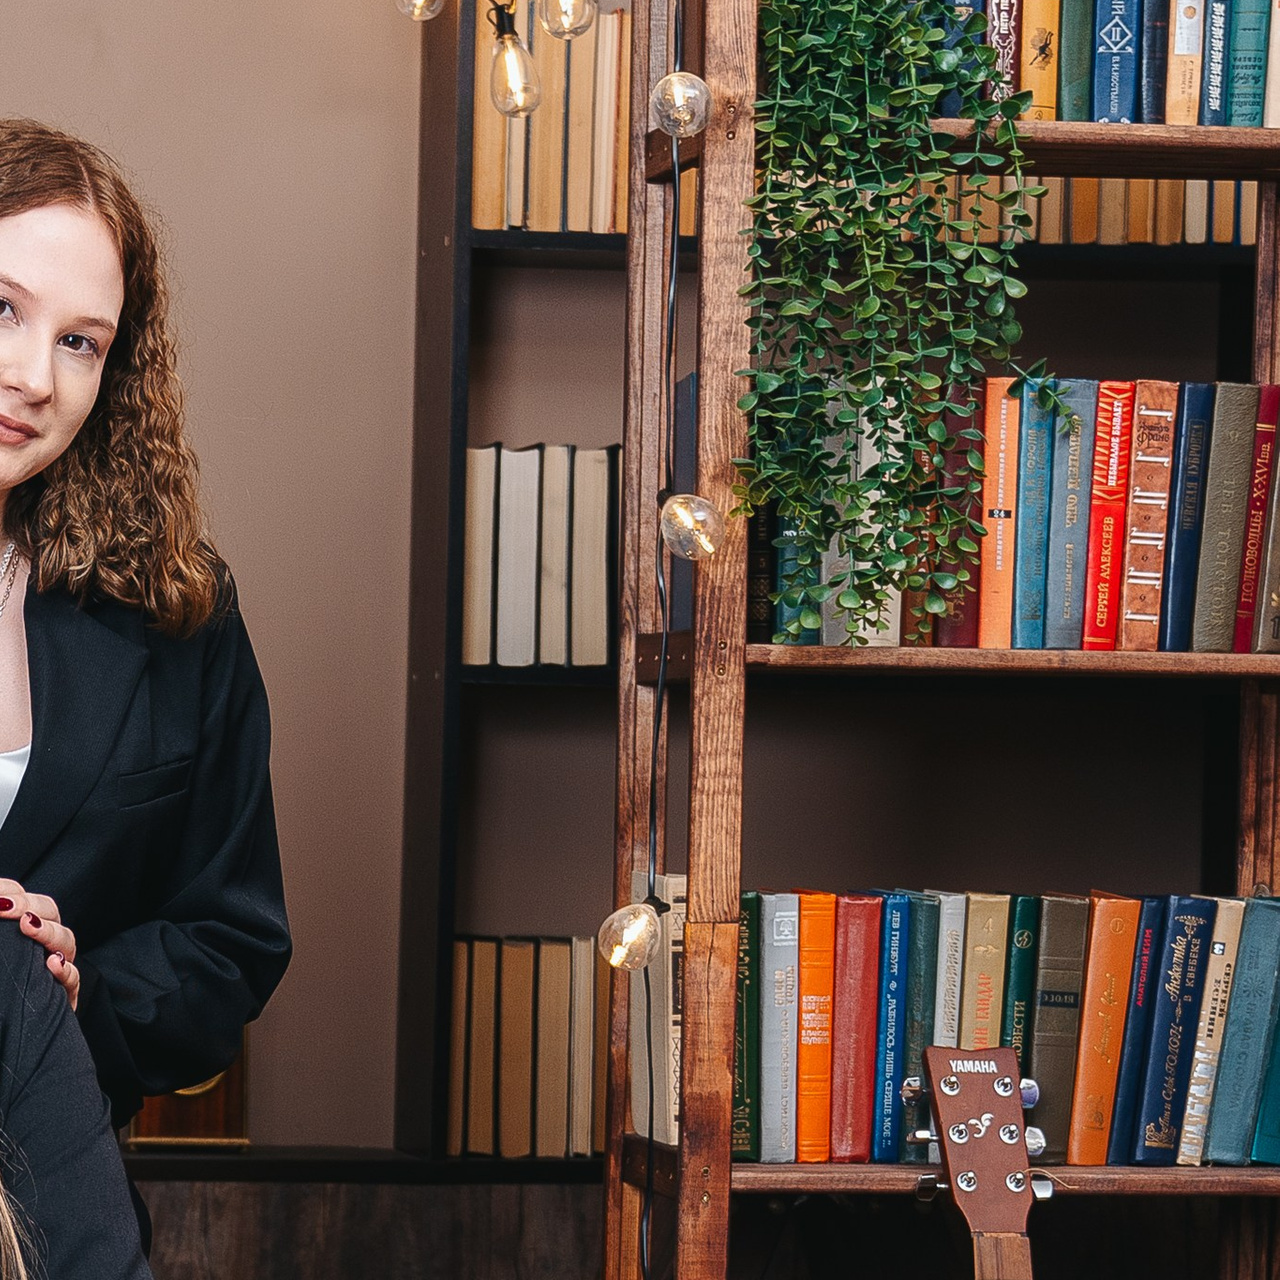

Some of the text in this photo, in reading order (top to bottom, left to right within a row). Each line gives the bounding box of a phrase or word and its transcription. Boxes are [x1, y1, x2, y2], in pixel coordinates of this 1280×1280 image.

[1000, 11, 1009, 34] ПЕТР
[1108, 401, 1124, 486] НЕБЫВАЛОЕ БЫВАЕТ
[1182, 424, 1204, 530] НЕВСКАЯ ДУБРОВКА
[993, 510, 1005, 518] 24
[1096, 516, 1114, 627] СЕРГЕЙ АЛЕКСЕЕВ
[1210, 478, 1234, 626] ЛЕВ ТОЛСТОЙ
[1241, 510, 1263, 602] ПОЛКОВОДЦЫ
[890, 910, 900, 975] ЛЕВ ГИНЗБУРГ
[1136, 928, 1153, 1007] АНАТОЛИЙ КИМ
[1164, 935, 1188, 1001] Анжелика
[1185, 938, 1200, 987] КВЕБЕКЕ
[977, 973, 992, 1020] ГАЙДАР
[1206, 979, 1221, 1039] ЕСЕНИН
[1219, 963, 1231, 1018] СЕРГЕЙ
[886, 1050, 894, 1078] ЛИШЬ
[950, 1059, 998, 1074] YAMAHA
[883, 1080, 893, 1115] СЕРДЦЕ
